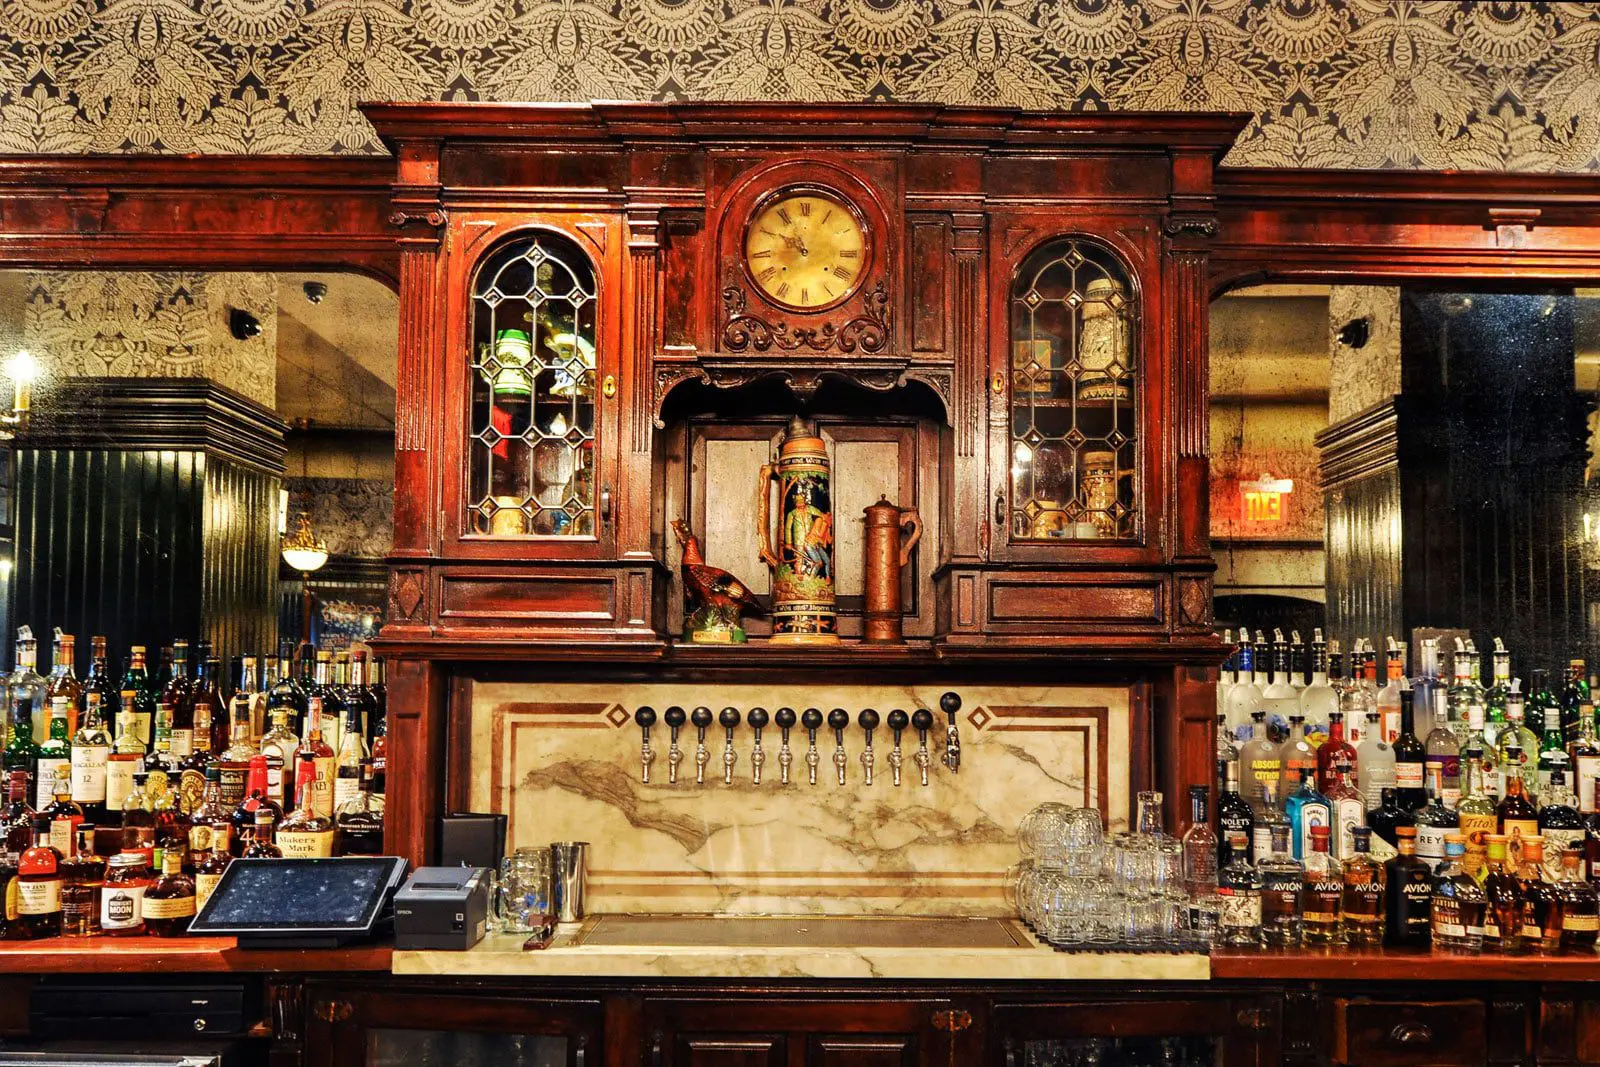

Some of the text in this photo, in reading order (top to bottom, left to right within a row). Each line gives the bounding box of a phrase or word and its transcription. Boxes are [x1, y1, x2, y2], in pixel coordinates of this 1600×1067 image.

[1465, 818, 1496, 829] Tito's
[279, 836, 317, 844] Maker's
[288, 844, 315, 852] Mark
[109, 906, 132, 914] MOON
